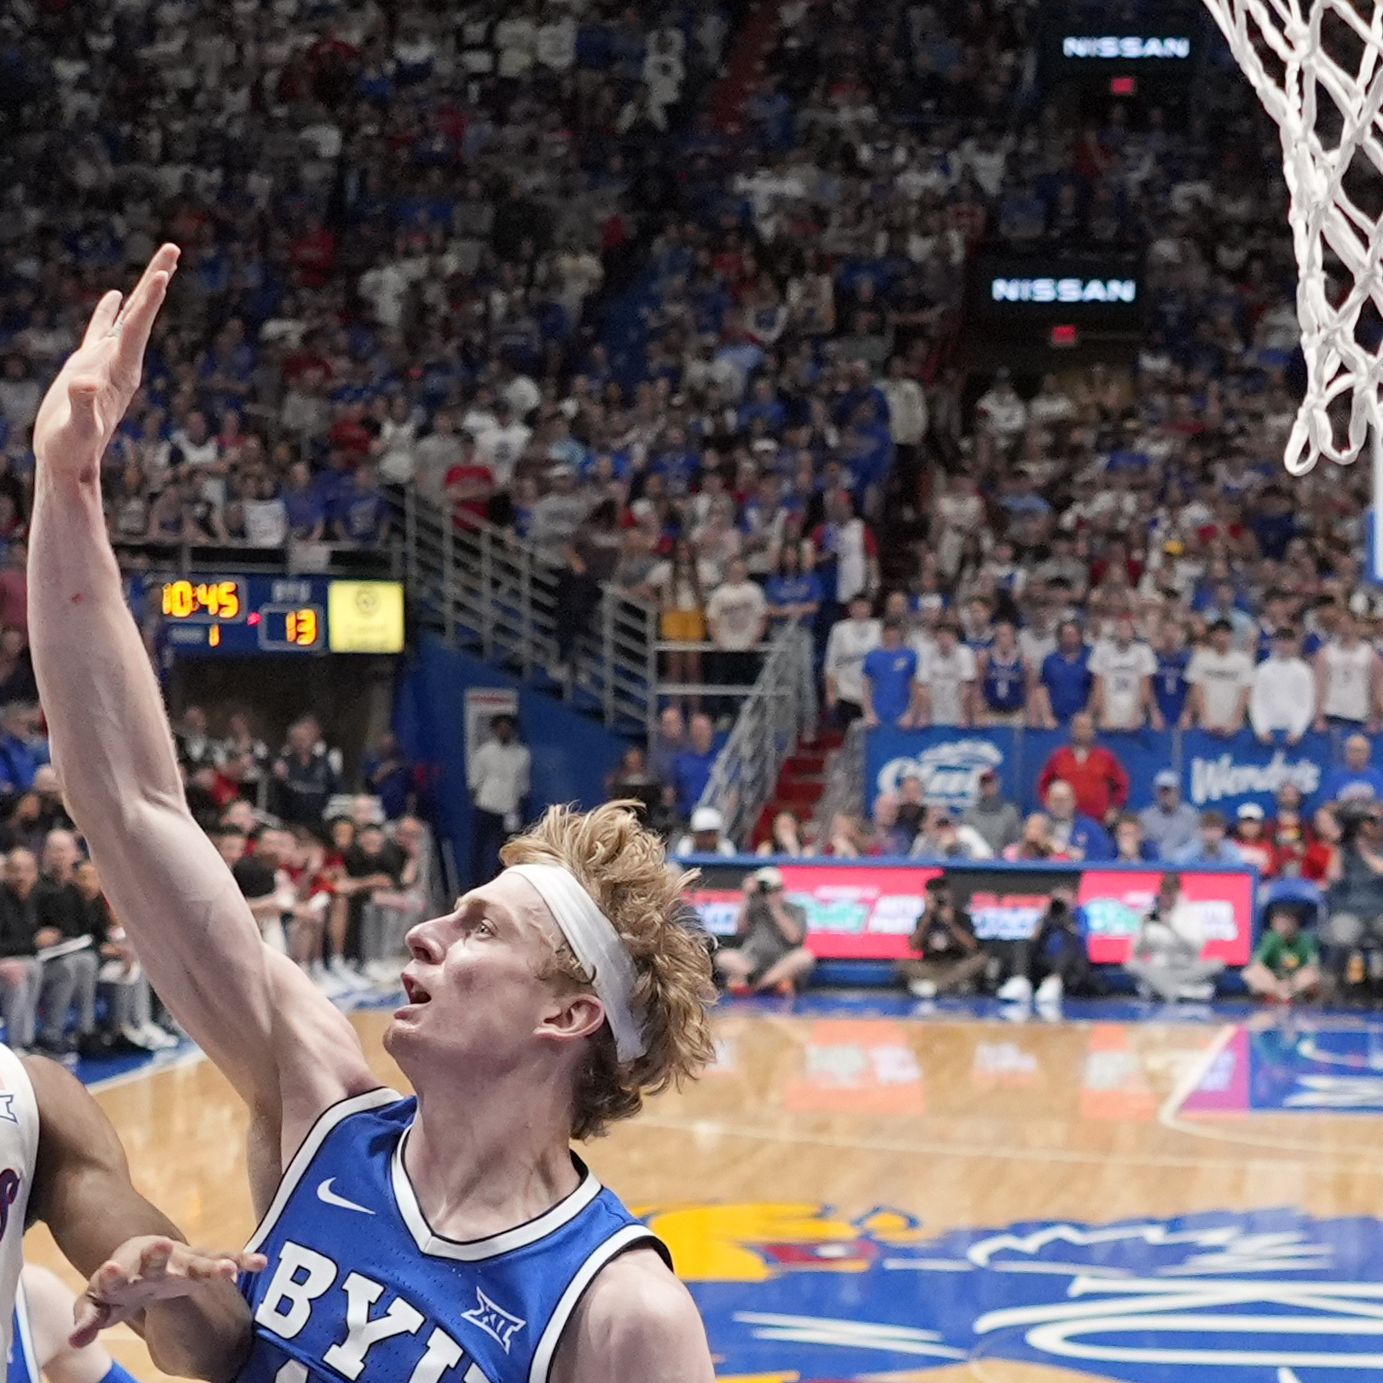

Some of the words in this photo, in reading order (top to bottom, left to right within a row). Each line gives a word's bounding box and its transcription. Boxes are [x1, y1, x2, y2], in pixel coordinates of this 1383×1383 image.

[1063, 36, 1190, 59] NISSAN
[992, 278, 1137, 303] NISSAN
[162, 580, 240, 619] 10:45
[209, 623, 220, 647] 1
[286, 608, 318, 646] 13
